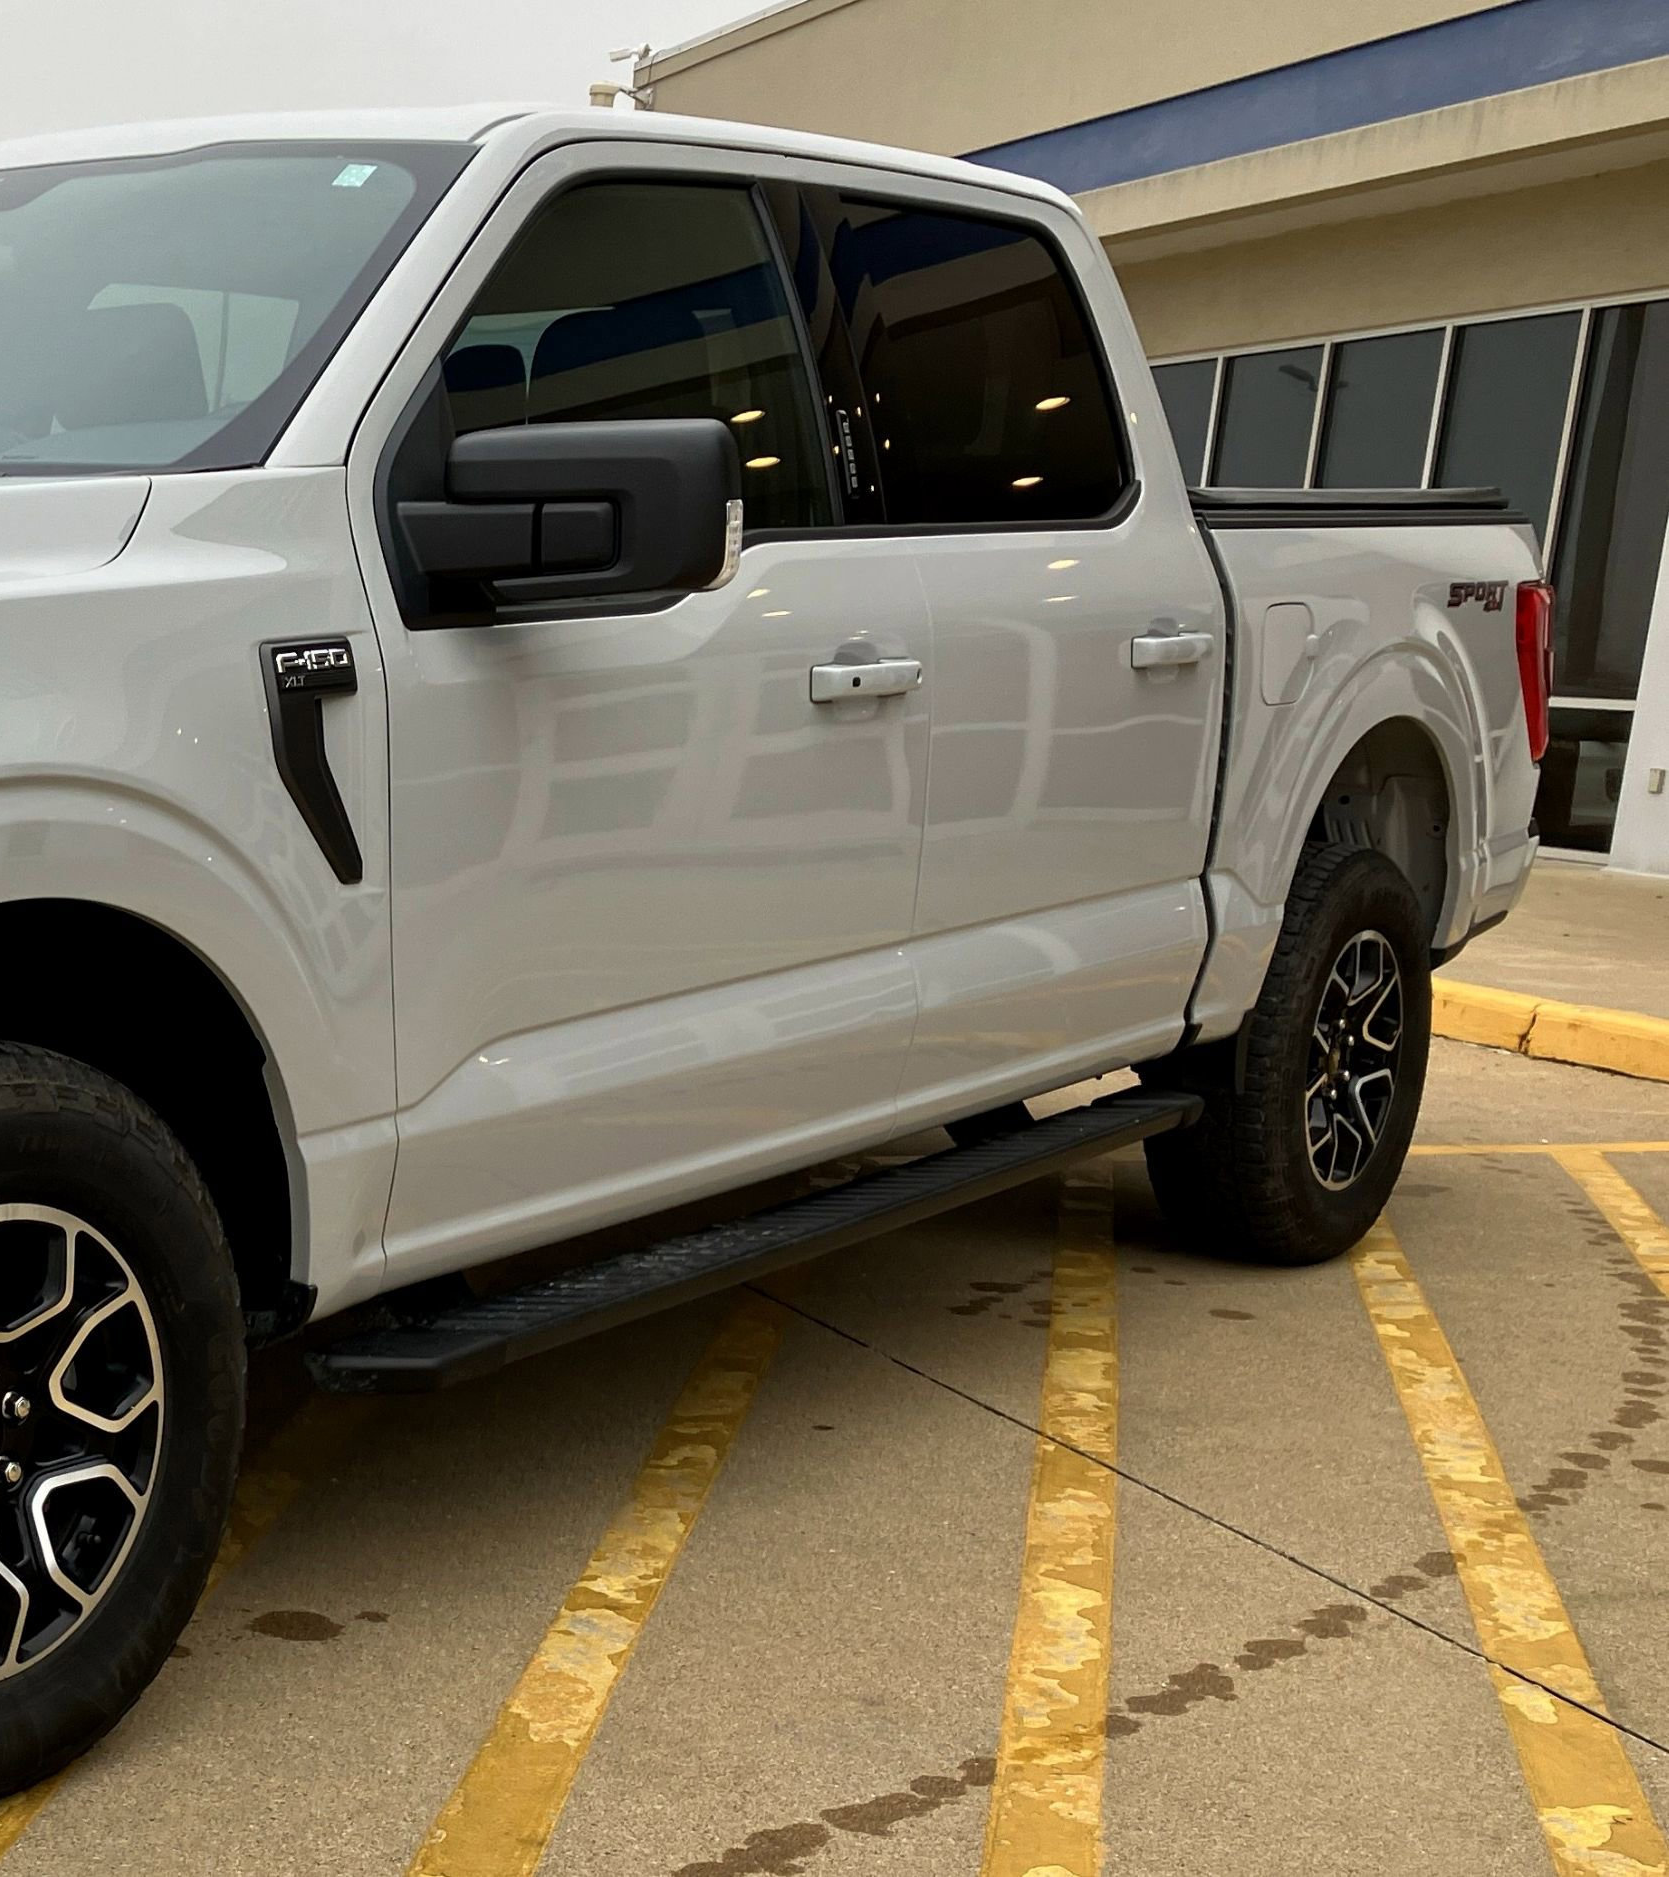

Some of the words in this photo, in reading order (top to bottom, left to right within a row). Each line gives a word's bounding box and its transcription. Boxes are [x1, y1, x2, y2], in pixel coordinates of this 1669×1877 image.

[1447, 580, 1509, 609] SPORT
[276, 648, 351, 673] F-150
[284, 675, 306, 688] XLT
